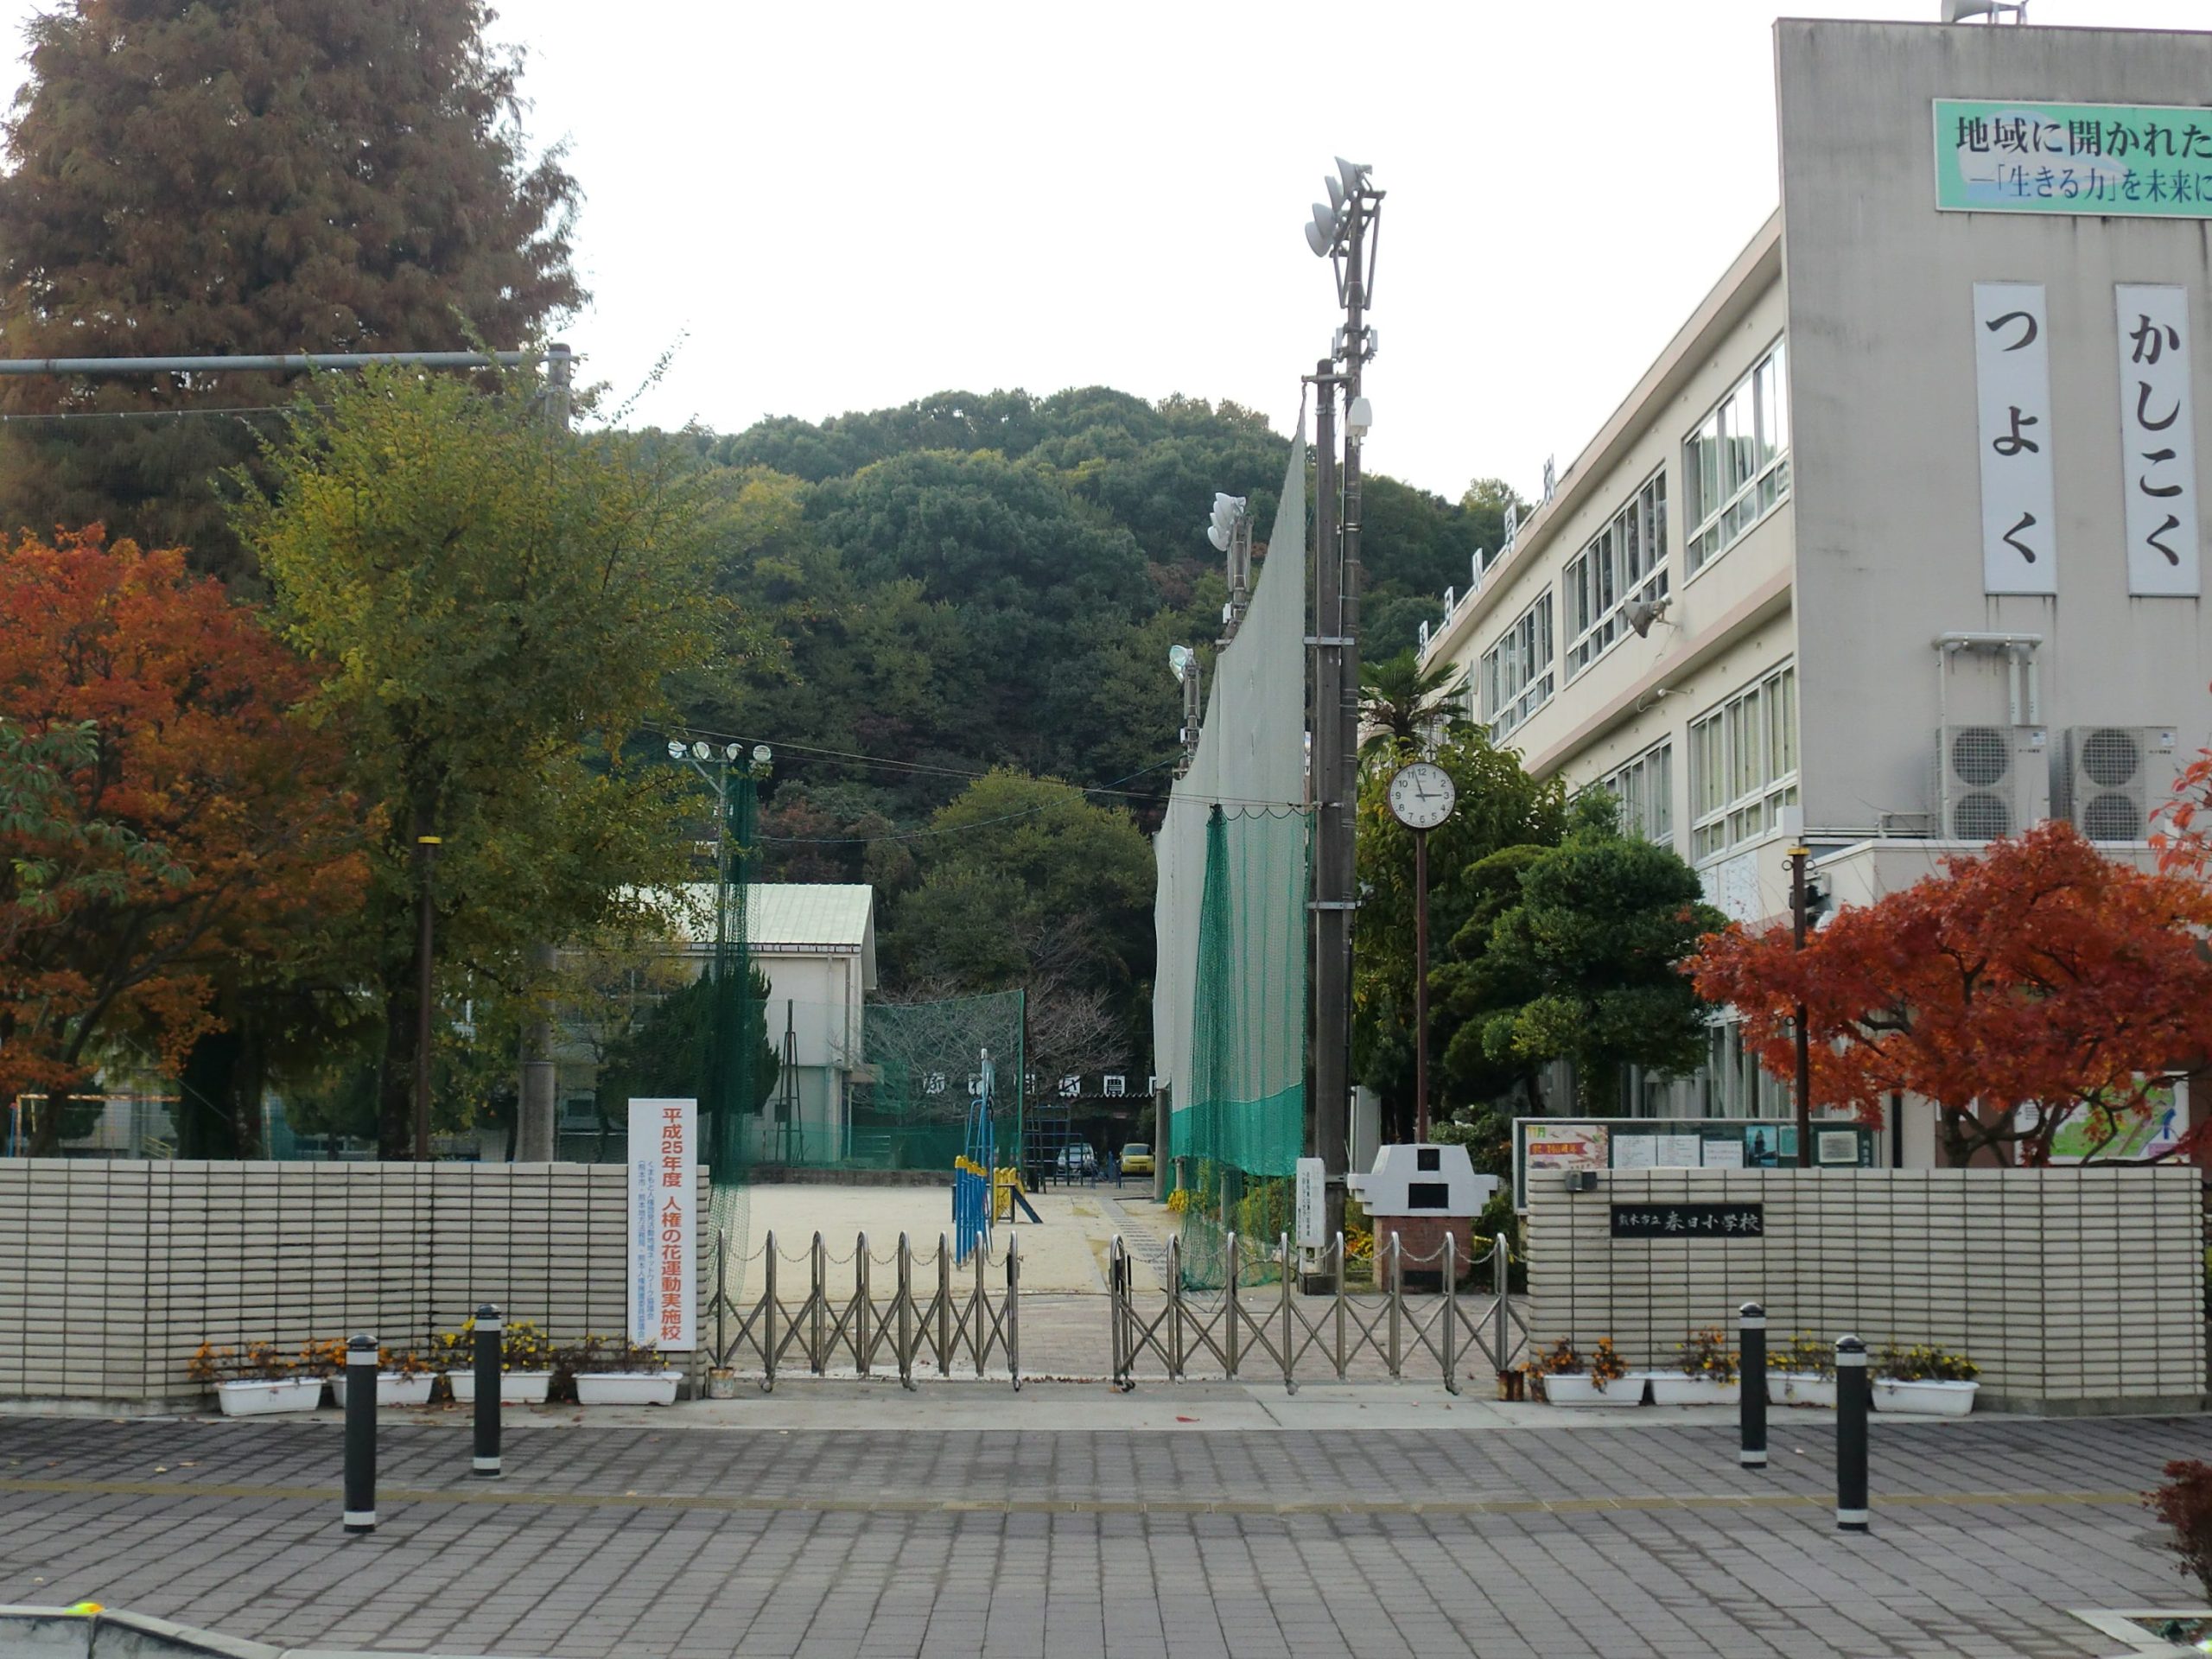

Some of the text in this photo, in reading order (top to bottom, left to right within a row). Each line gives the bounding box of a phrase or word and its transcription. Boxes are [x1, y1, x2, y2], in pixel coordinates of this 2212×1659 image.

[1956, 116, 2212, 158] 地域に開かれた
[1986, 311, 2039, 563] つよく
[2129, 314, 2183, 567] かしこく
[661, 1108, 683, 1341] 平成25年度 人権の花運動実施校
[1664, 1211, 1761, 1232] 春日小学校
